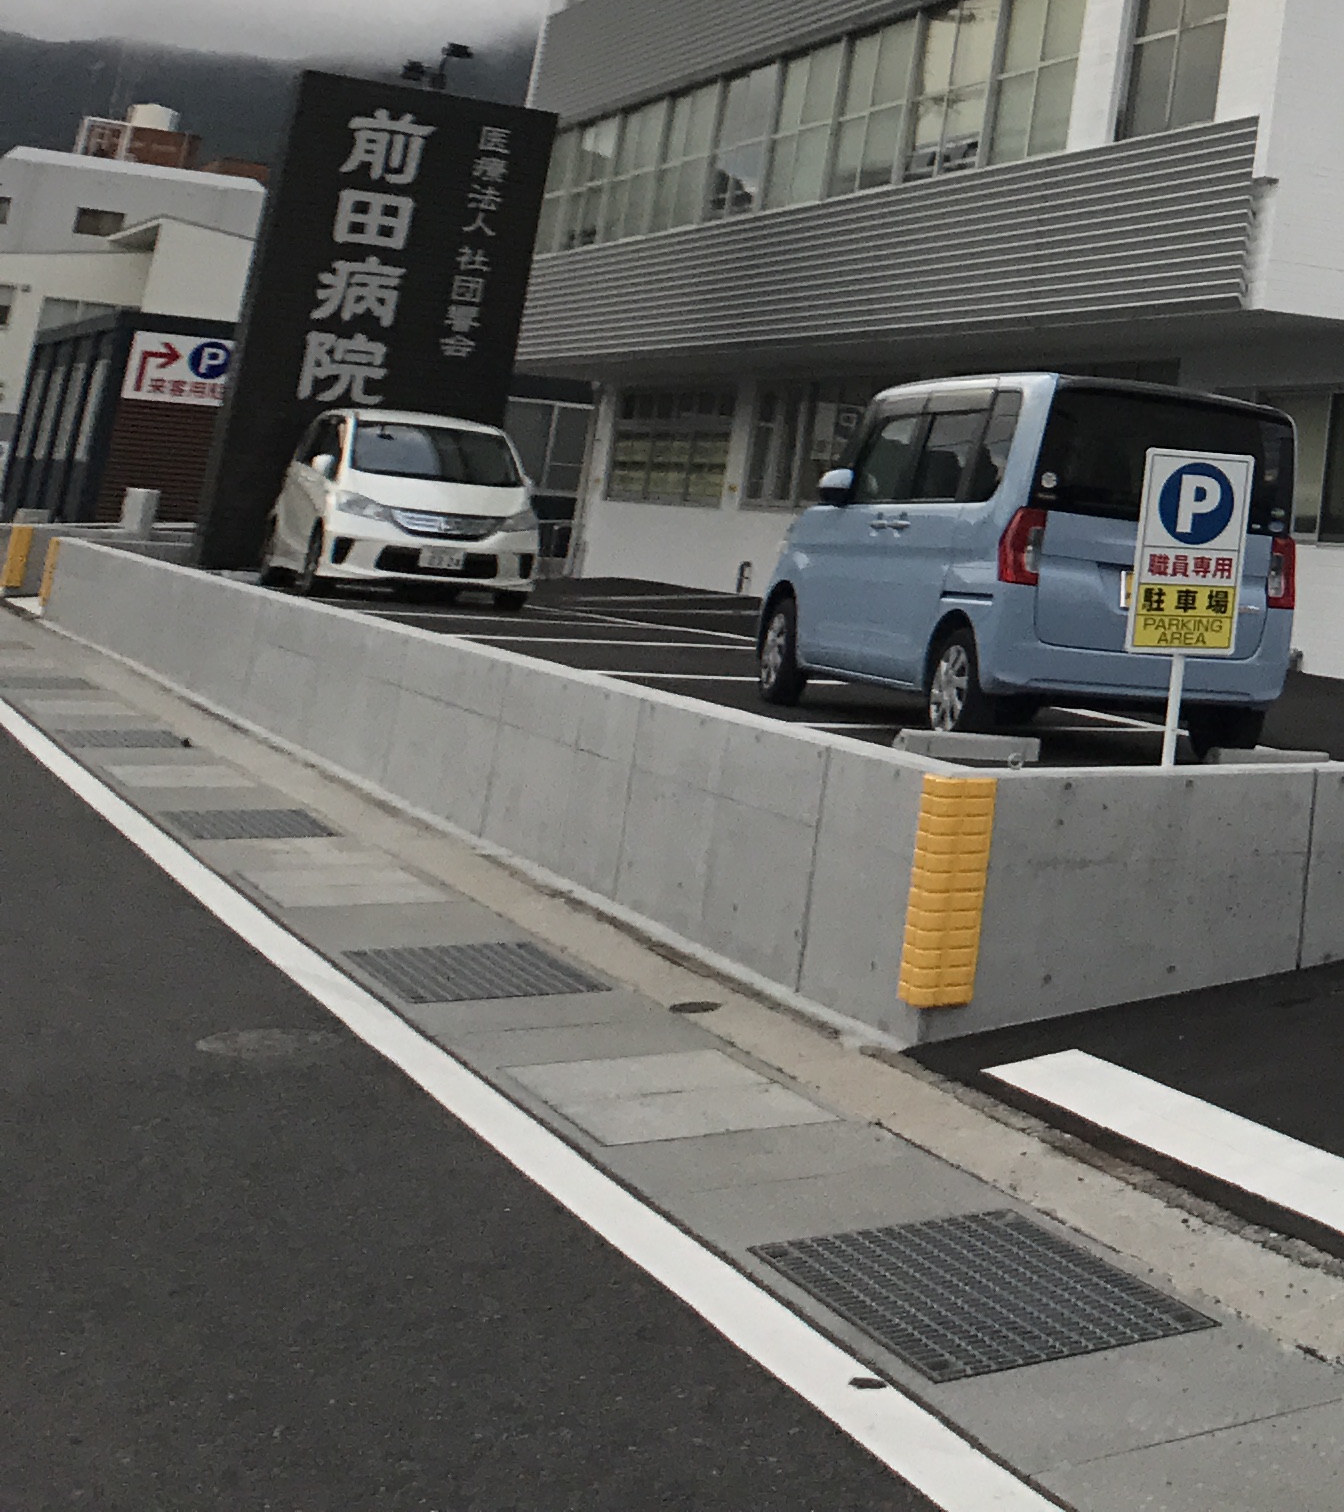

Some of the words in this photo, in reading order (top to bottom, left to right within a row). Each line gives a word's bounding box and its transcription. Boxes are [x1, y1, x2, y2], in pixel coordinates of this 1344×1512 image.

[296, 107, 438, 406] 前田病院
[199, 347, 226, 374] P
[1176, 474, 1221, 533] P
[1147, 553, 1233, 580] 職員専用
[1142, 587, 1229, 614] 駐車場
[1143, 617, 1223, 634] PARKING
[1156, 631, 1207, 646] AREA
